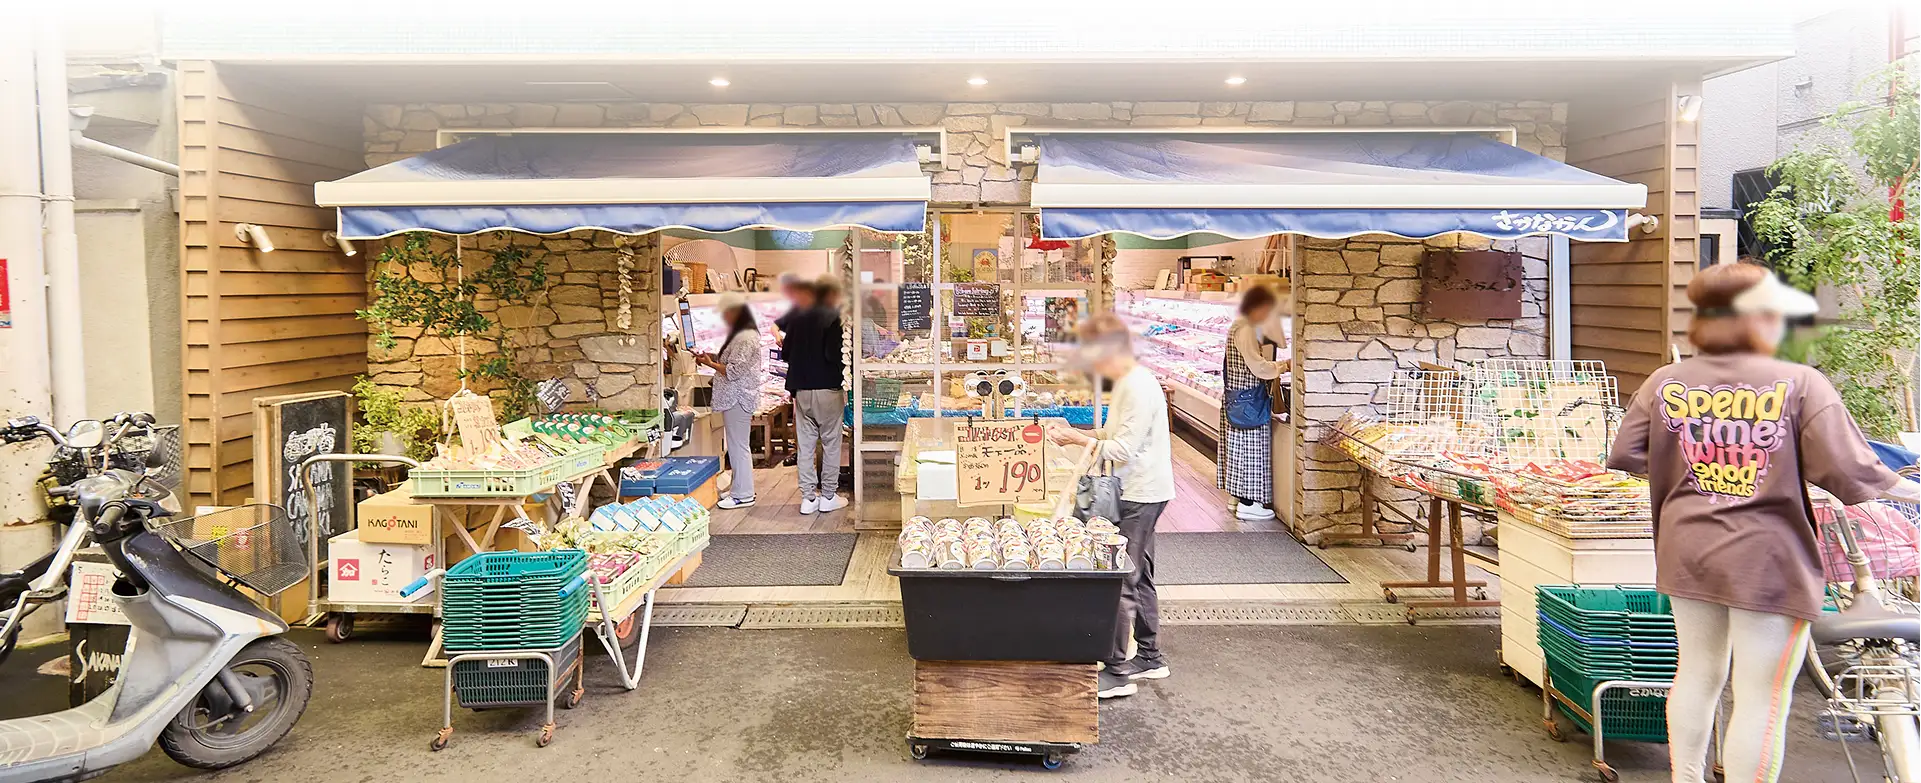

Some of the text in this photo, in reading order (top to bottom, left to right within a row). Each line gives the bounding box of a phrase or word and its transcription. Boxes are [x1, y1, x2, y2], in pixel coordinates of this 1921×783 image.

[1661, 381, 1789, 422] Spend
[1671, 417, 1778, 448] Time
[1684, 442, 1767, 470] with
[999, 461, 1041, 493] 190
[1691, 460, 1759, 483] good
[1698, 479, 1756, 497] friends
[367, 517, 418, 530] KAGOTANI
[378, 548, 393, 586] たらこ
